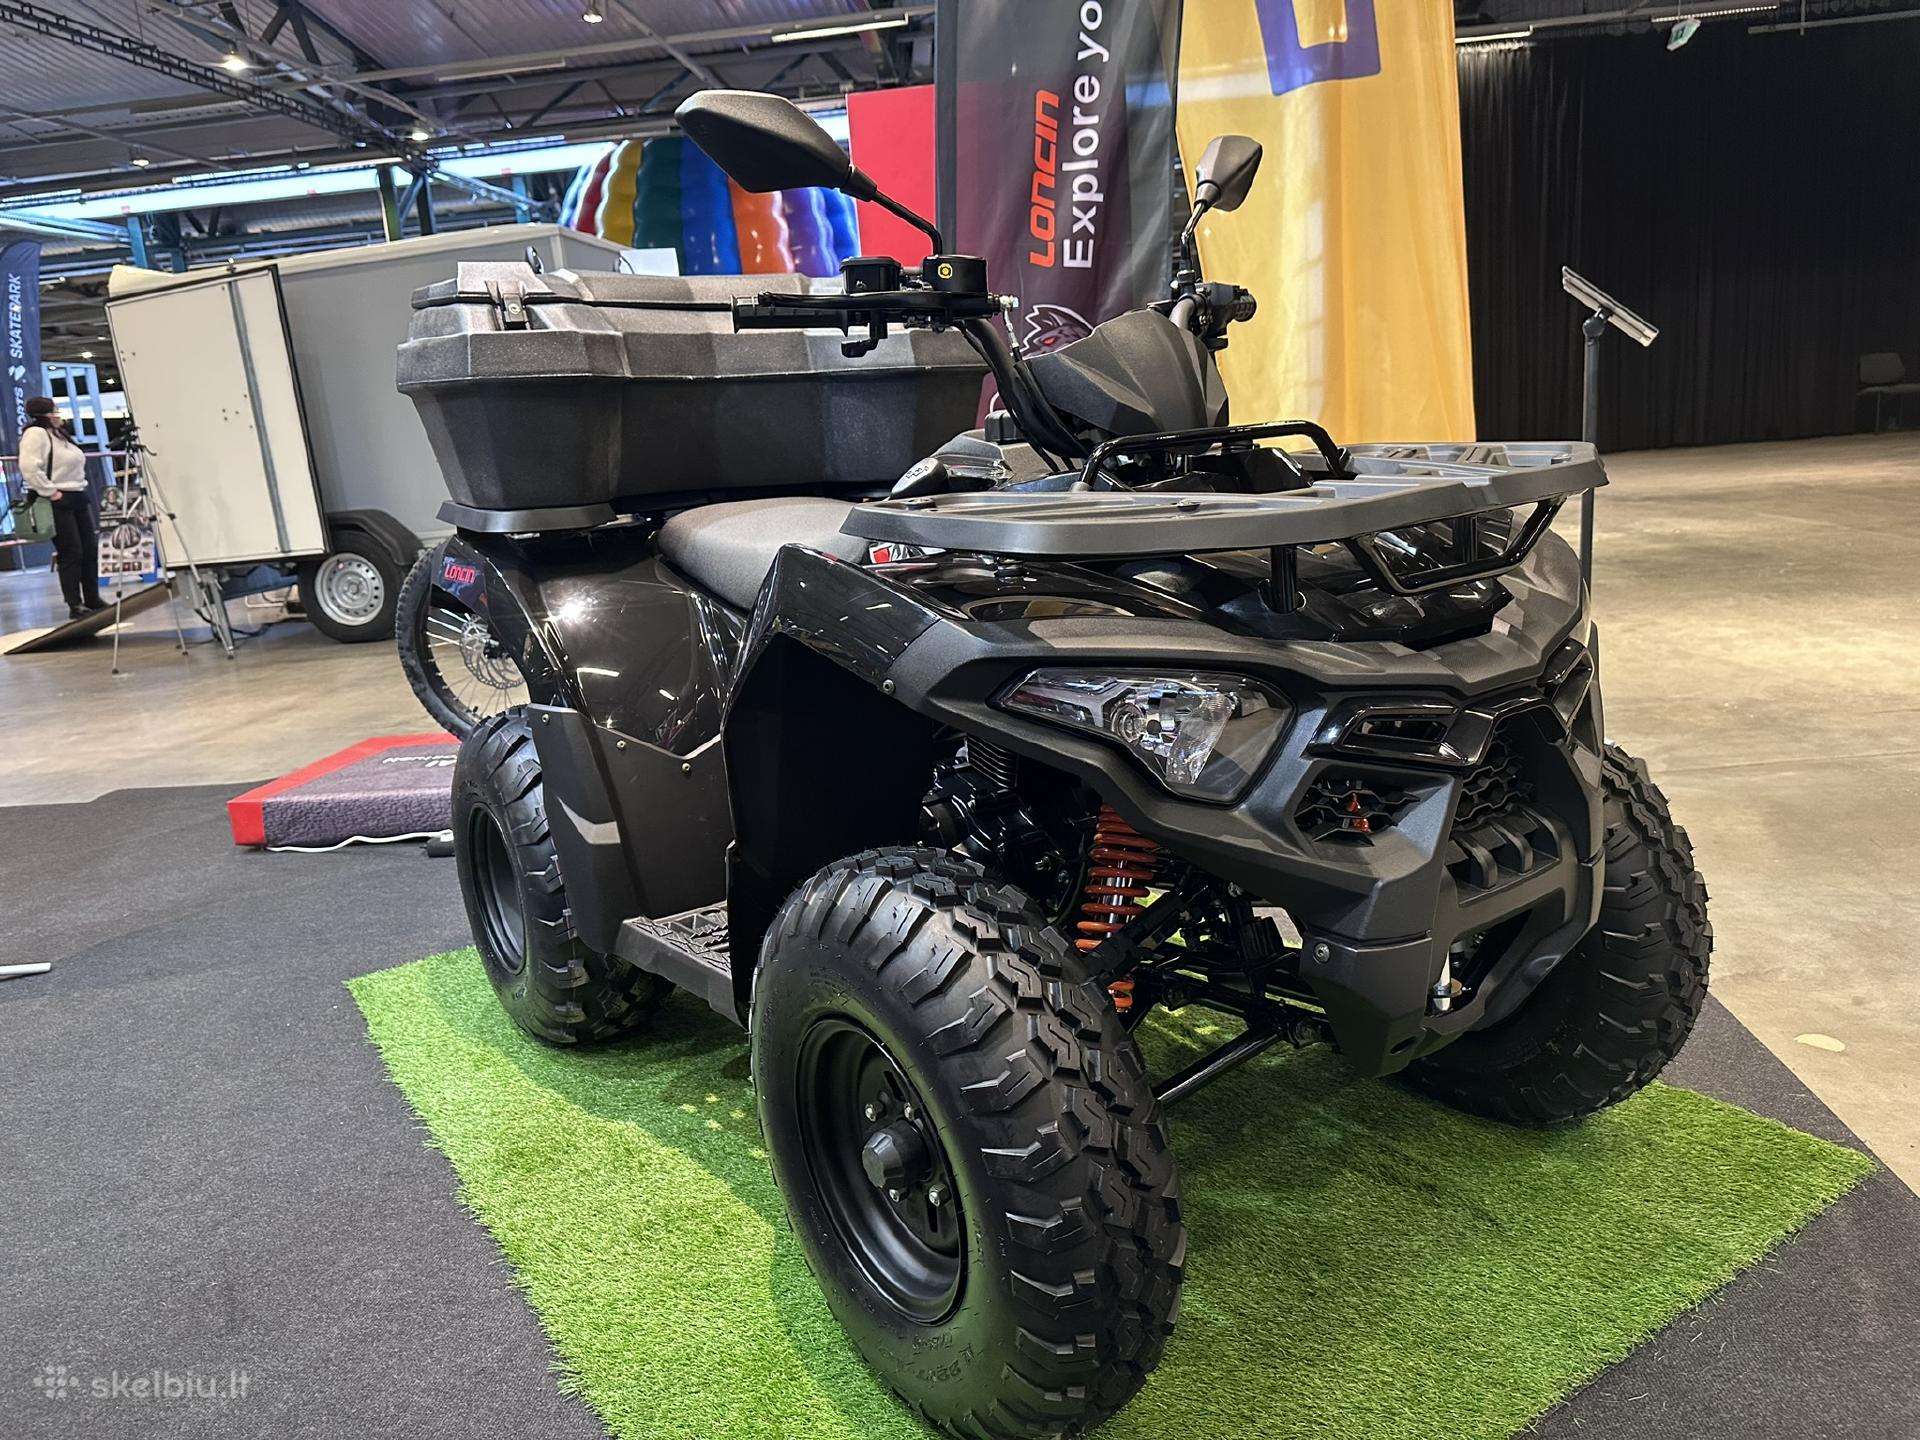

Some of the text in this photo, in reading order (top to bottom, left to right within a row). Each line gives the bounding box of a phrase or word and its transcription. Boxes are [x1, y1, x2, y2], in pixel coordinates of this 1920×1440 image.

[1062, 0, 1109, 268] Explore yo
[8, 272, 23, 359] SKATEPARK
